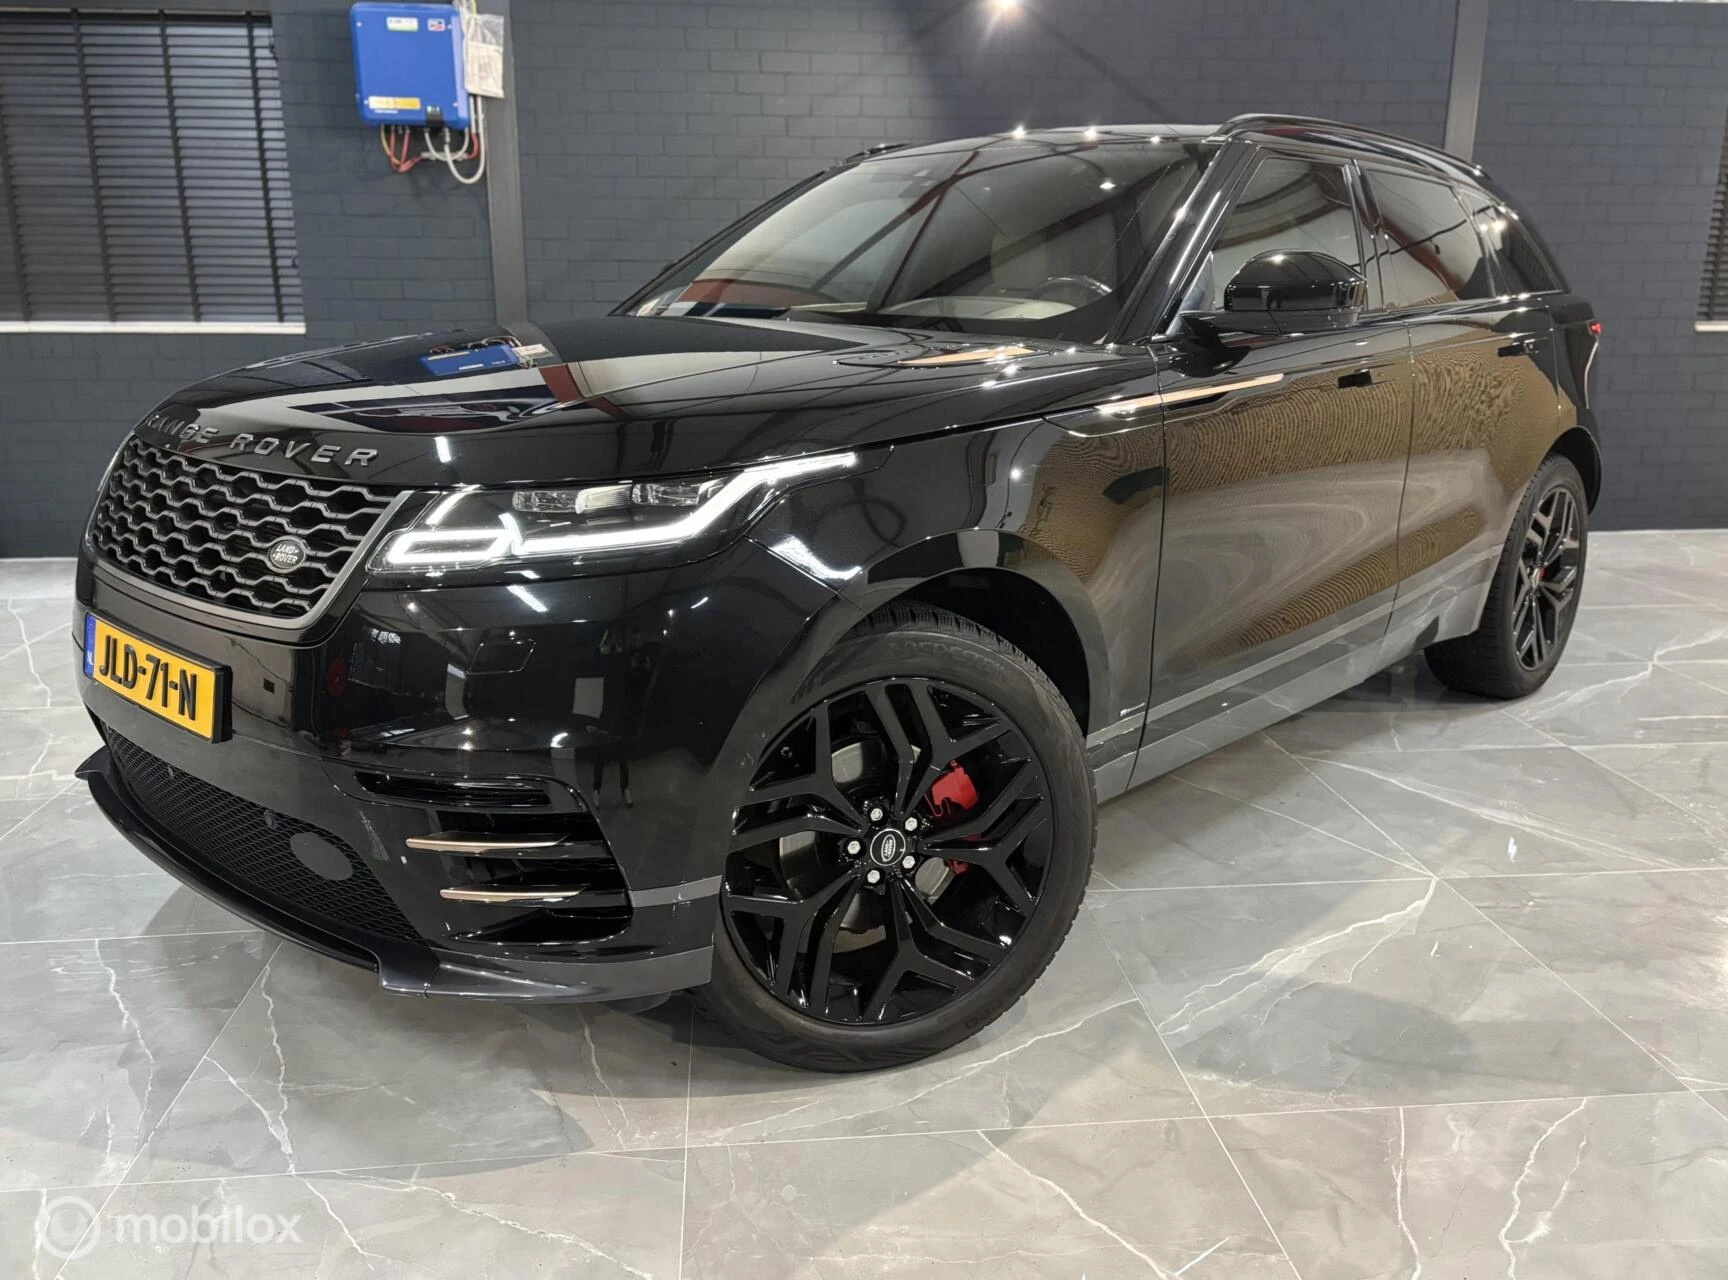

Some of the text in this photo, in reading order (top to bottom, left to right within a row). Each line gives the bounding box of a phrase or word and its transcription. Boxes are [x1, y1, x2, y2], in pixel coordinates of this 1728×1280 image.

[229, 433, 379, 467] ROVER
[274, 553, 298, 565] ROVER
[276, 543, 296, 553] LAND
[99, 634, 198, 722] JLD-71-N
